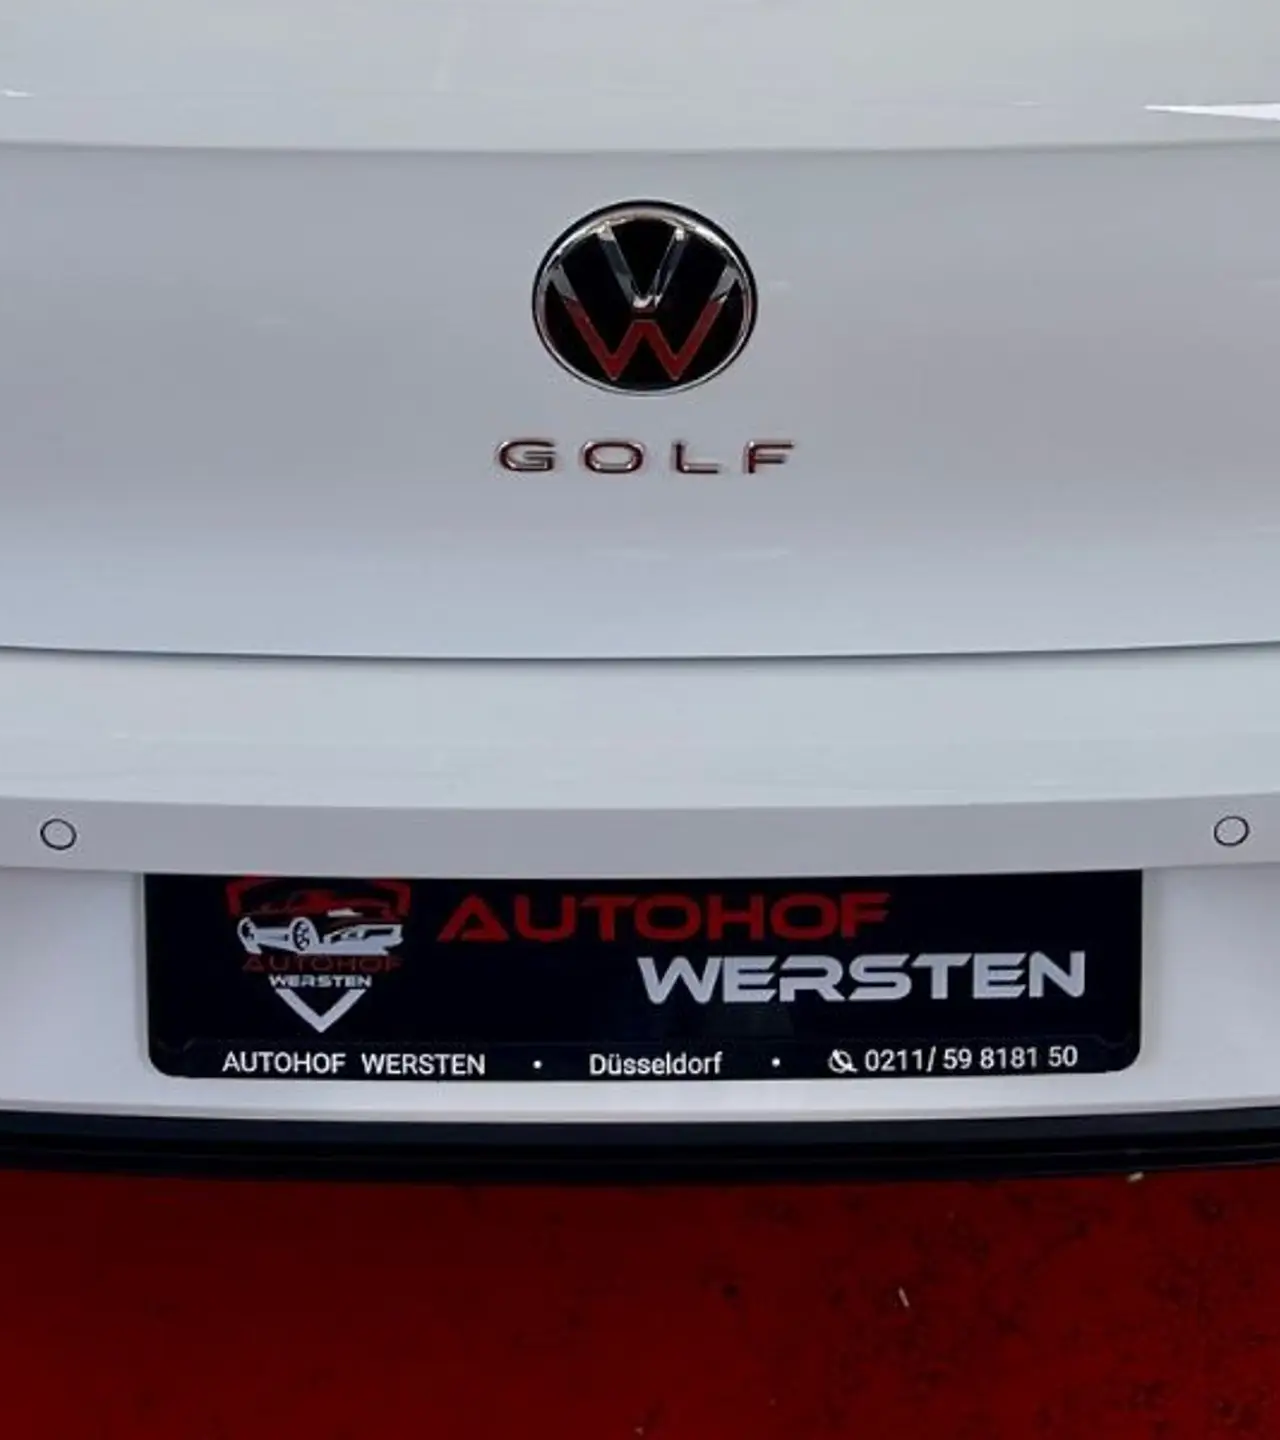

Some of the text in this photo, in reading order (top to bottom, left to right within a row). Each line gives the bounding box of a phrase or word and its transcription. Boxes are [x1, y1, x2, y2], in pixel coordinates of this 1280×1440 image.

[497, 437, 796, 474] GOLF
[437, 893, 891, 942] AUTOHOF
[241, 954, 403, 973] AUTOHOF
[637, 951, 1085, 1004] WERSTEN
[268, 974, 372, 988] WERSTEN
[221, 1050, 347, 1075] AUTOHOF
[360, 1052, 486, 1076] WERSTEN
[589, 1051, 723, 1076] Düsseldorf
[942, 1047, 973, 1070] 59
[979, 1046, 1038, 1070] 8181
[1048, 1045, 1079, 1068] 50
